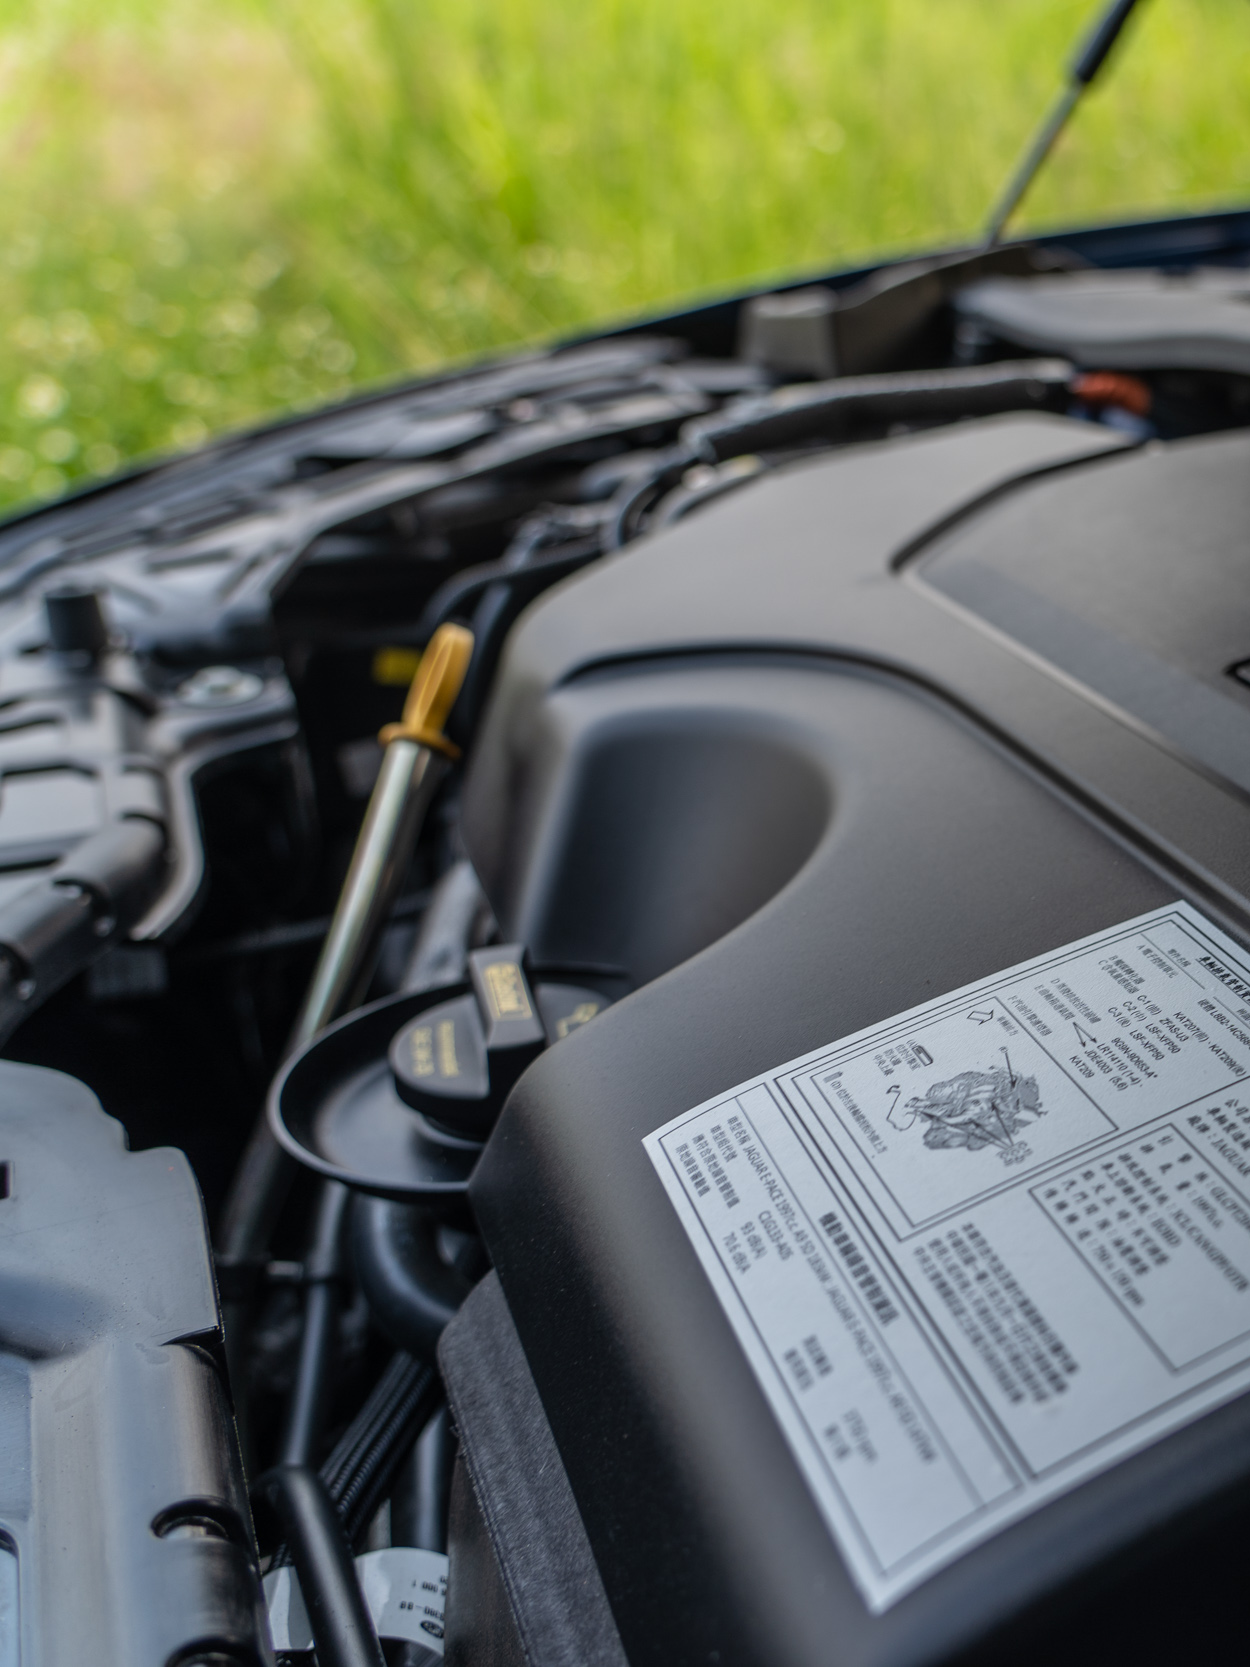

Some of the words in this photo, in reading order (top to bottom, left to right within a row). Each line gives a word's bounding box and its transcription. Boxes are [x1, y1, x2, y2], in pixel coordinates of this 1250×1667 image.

[1128, 1028, 1166, 1061] LSF-XFP50
[1143, 1022, 1182, 1054] LSF-XFP50
[1157, 1016, 1190, 1043] ZFAS-U3
[1067, 1054, 1095, 1079] KAT209
[1082, 1047, 1113, 1075] JDE4003
[741, 1143, 770, 1175] JAGUAR
[757, 1171, 786, 1203] E-PACE
